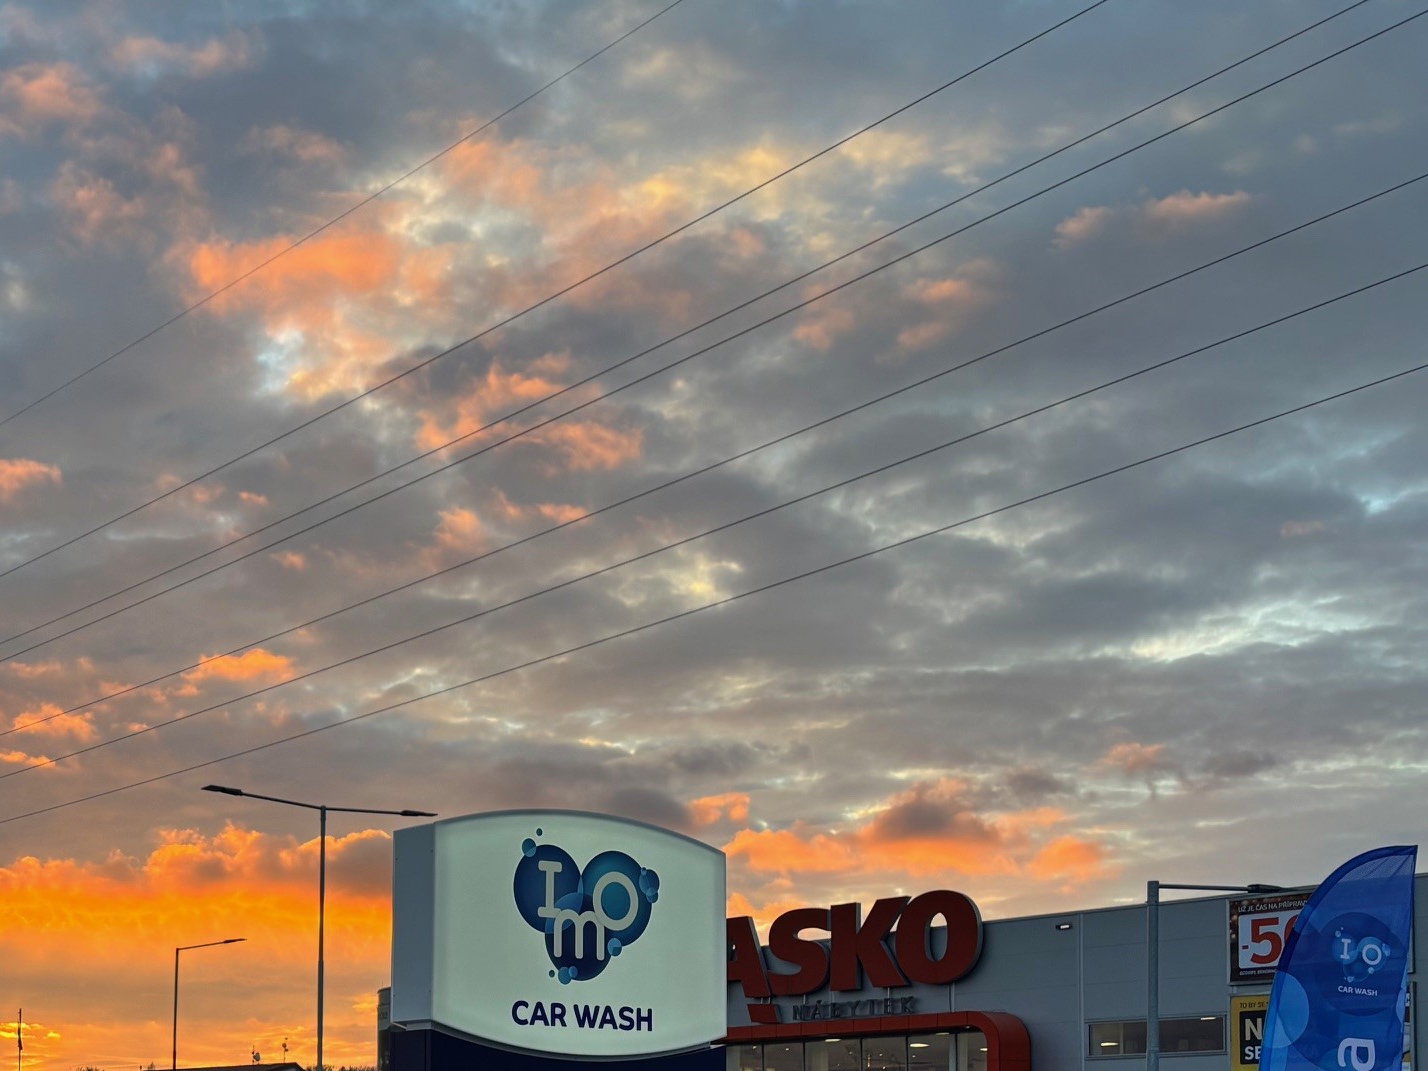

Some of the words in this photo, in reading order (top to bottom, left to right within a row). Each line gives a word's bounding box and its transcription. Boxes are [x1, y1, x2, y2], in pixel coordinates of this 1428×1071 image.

[1256, 903, 1268, 911] ČAS
[1268, 902, 1278, 910] NA
[1337, 985, 1354, 994] CAR
[1354, 986, 1378, 997] WASH
[511, 1000, 567, 1027] CAR
[573, 1003, 653, 1032] WASH
